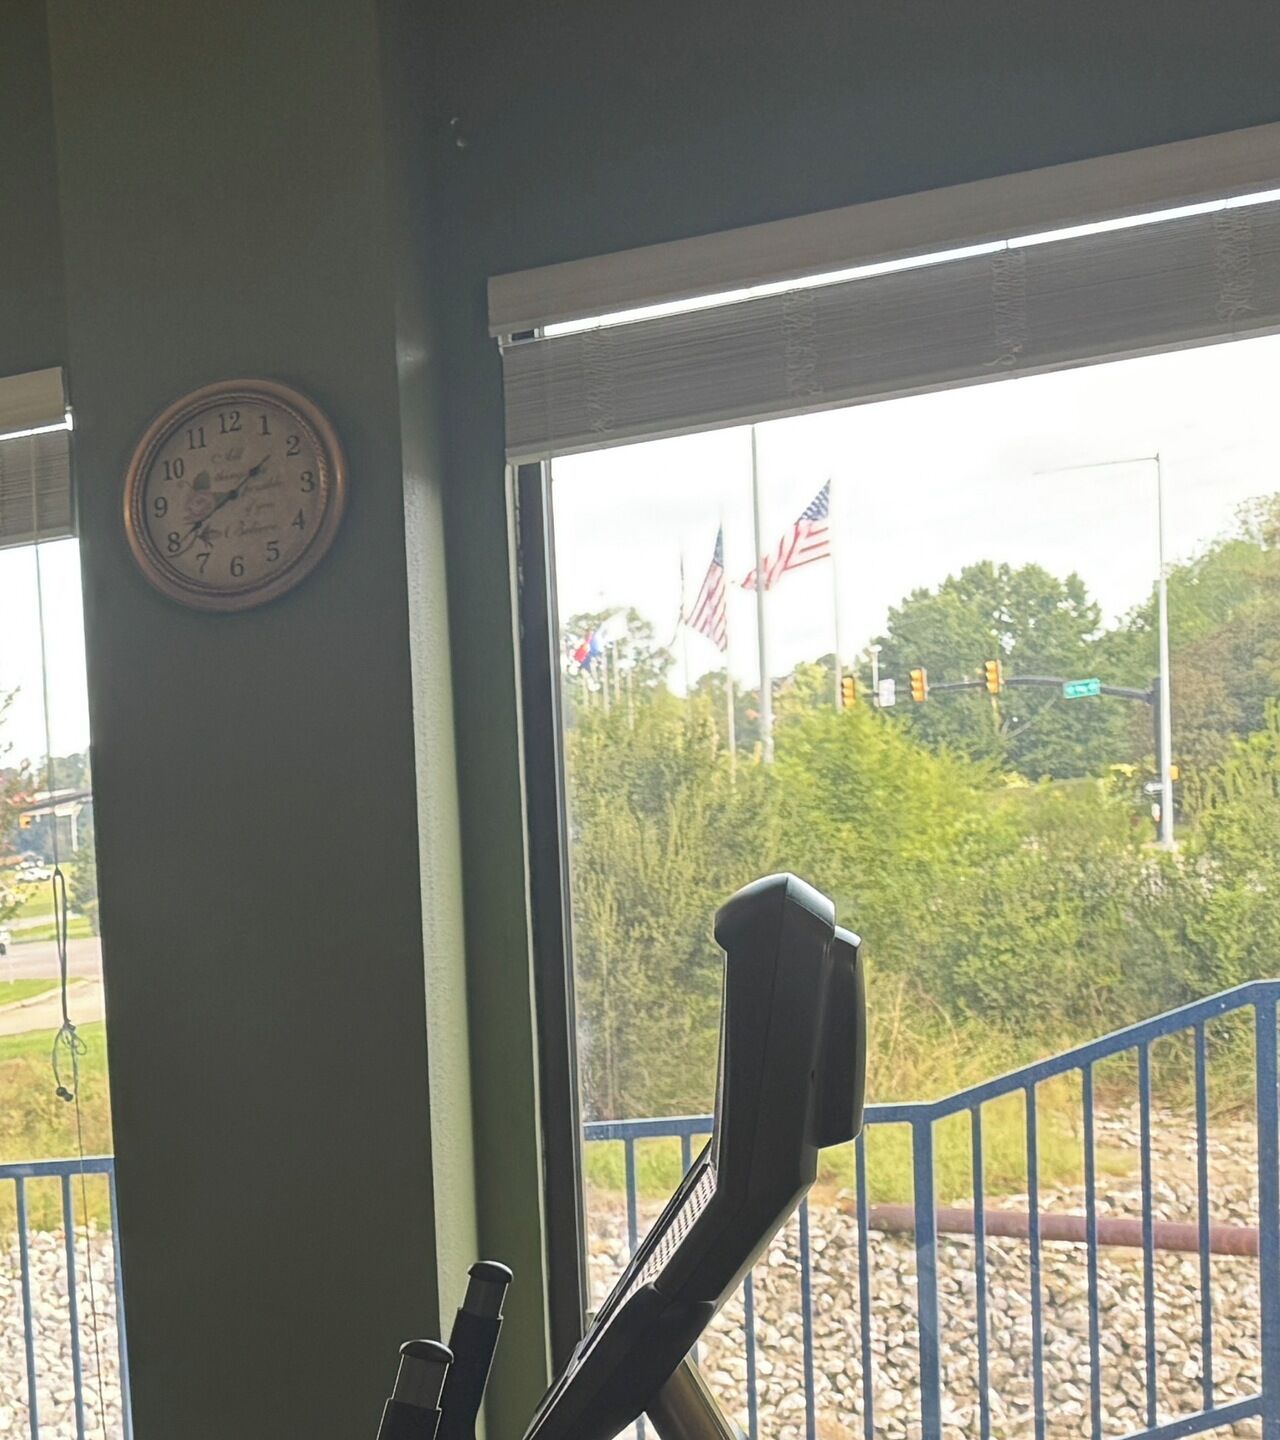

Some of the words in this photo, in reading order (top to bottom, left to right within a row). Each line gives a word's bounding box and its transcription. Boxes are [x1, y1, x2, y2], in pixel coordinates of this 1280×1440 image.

[218, 411, 242, 434] 12
[258, 415, 272, 435] 1
[187, 427, 207, 450] 11
[286, 435, 301, 456] 2
[163, 458, 184, 481] 10
[300, 471, 315, 493] 3
[154, 497, 168, 518] 9
[292, 509, 305, 530] 4
[167, 532, 181, 553] 8
[266, 541, 280, 562] 5
[196, 553, 210, 574] 7
[230, 556, 244, 577] 6
